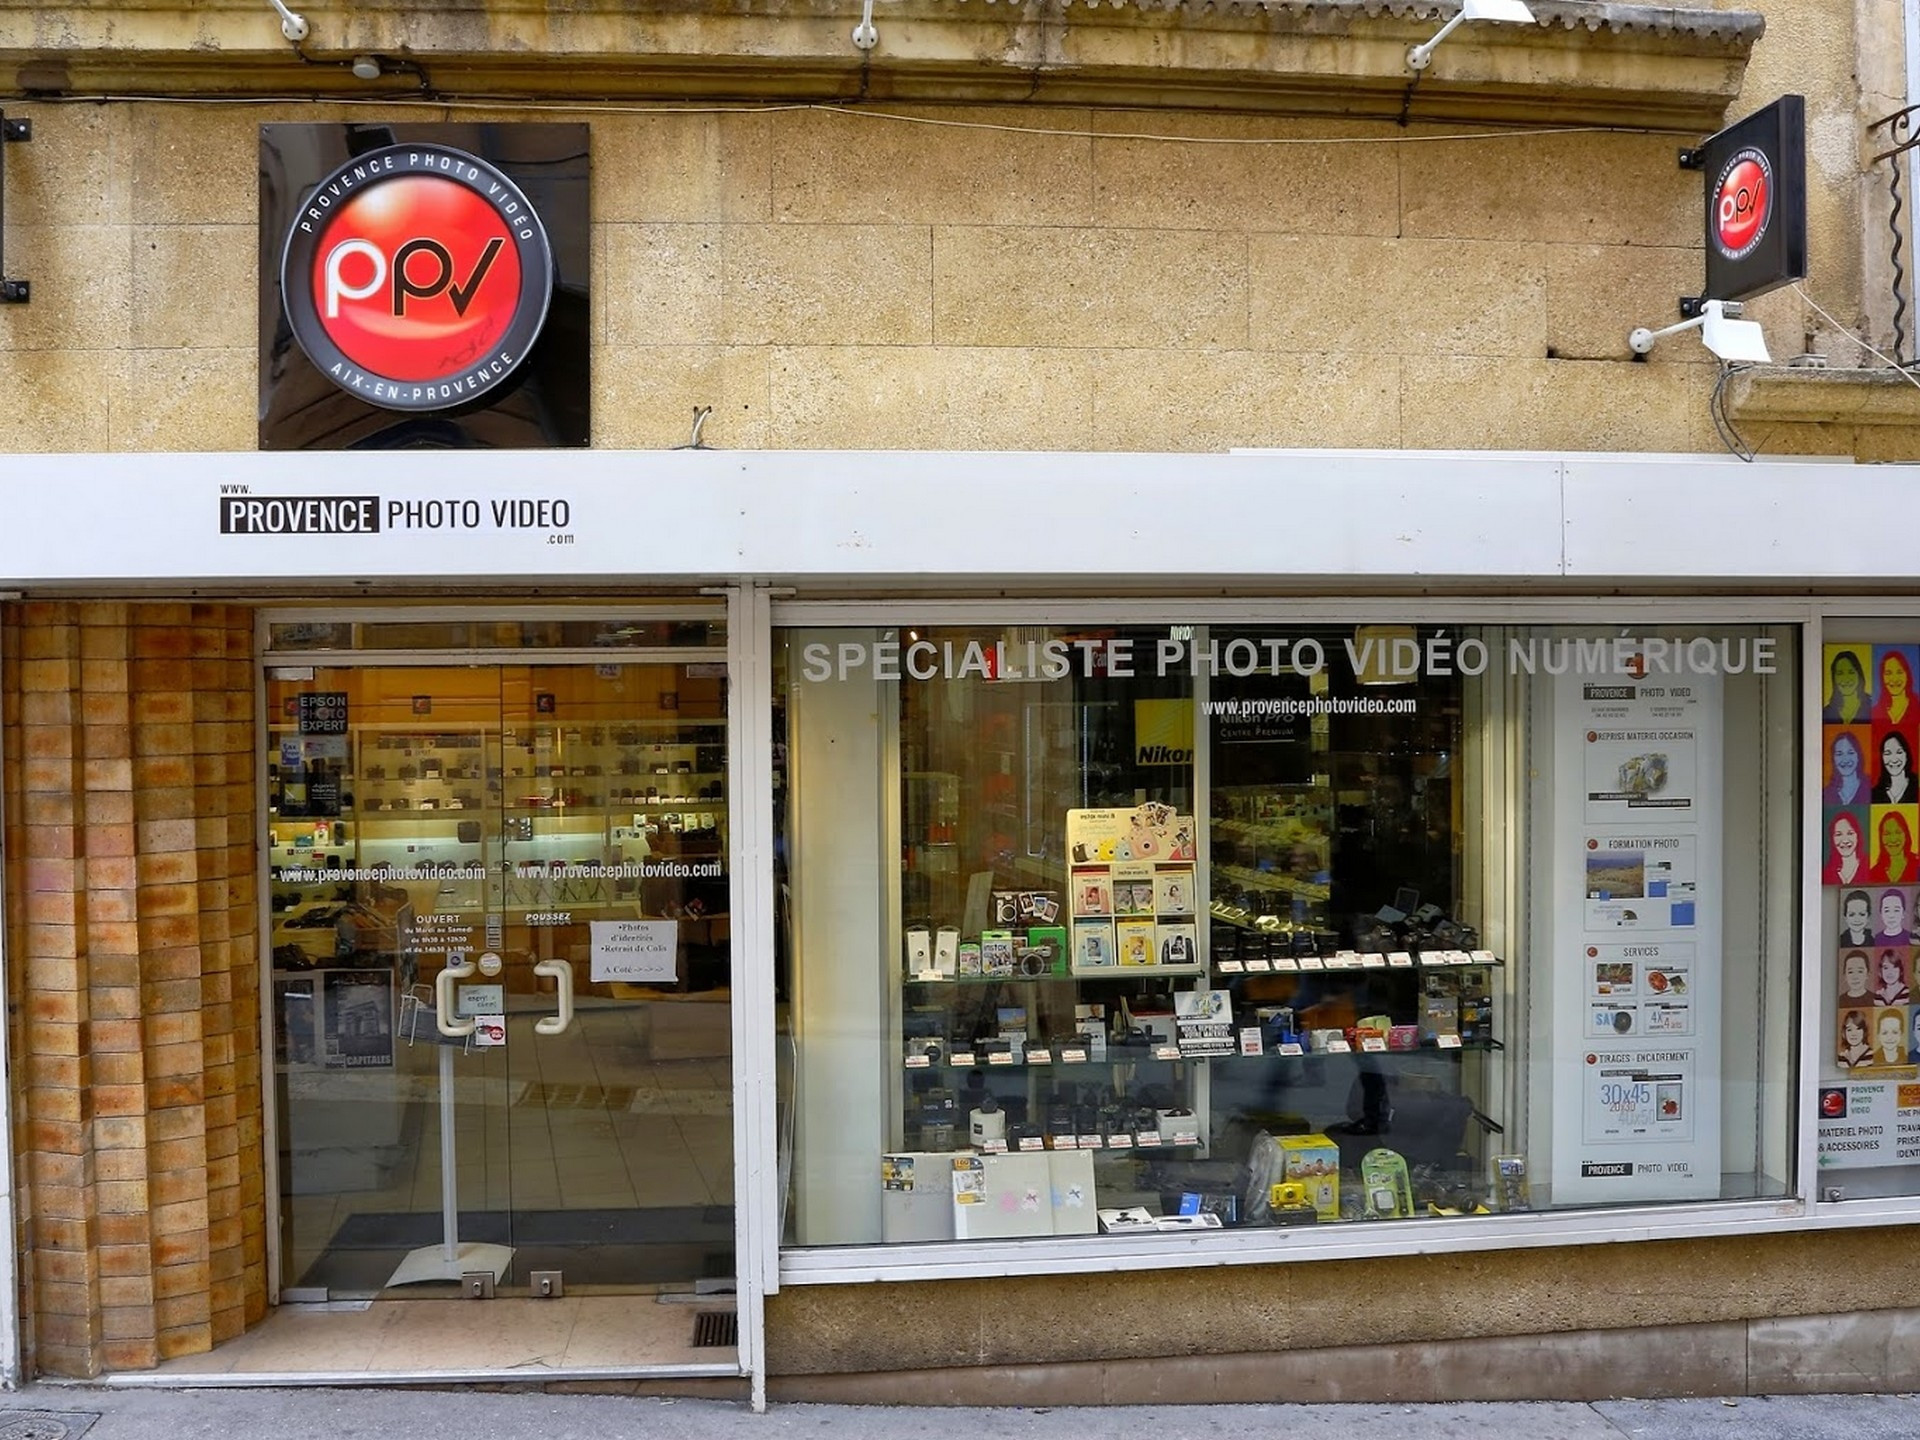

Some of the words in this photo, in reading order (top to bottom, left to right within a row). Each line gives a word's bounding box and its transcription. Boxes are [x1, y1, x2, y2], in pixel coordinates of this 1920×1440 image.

[301, 155, 395, 233] PROVENCE
[409, 152, 480, 182] PHOTO
[488, 181, 534, 241] VIDÉO
[330, 351, 513, 400] AIX-EN-PROVENCE
[229, 500, 373, 532] PROVENCE
[388, 500, 480, 529] PHOTO
[491, 499, 570, 528] VIDEO
[546, 534, 575, 545] .com
[802, 632, 1135, 682] SPÉCIALISTE
[1156, 637, 1325, 678] PHOTO
[1343, 630, 1489, 677] VIDÉO
[1510, 629, 1778, 677] NUMÉRIQUE
[1640, 687, 1665, 697] PHOTO
[1669, 687, 1691, 697] VIDEO
[300, 696, 346, 707] EPSON
[1201, 697, 1417, 717] www.provencephotovideo.com
[300, 719, 346, 731] EXPERT
[1609, 839, 1652, 849] FORMATION
[1653, 838, 1680, 848] PHOTO
[280, 862, 486, 883] www.provencephotovideo.com
[515, 861, 722, 881] www.provencephotovideo.com
[416, 915, 461, 924] OUVERT
[525, 912, 571, 921] POUSSEZ
[604, 944, 633, 952] Retrait
[1623, 946, 1660, 957] SERVICES
[347, 1054, 391, 1066] CAPITALES
[1599, 1053, 1631, 1064] TIRAGES
[1636, 1051, 1690, 1063] ENCADREMENT
[1600, 1083, 1651, 1105] 30x45
[1851, 1085, 1885, 1094] PROVENCE
[1898, 1085, 1920, 1097] Kod
[1851, 1096, 1872, 1104] PHOTO
[1851, 1106, 1871, 1114] VIDEO
[1818, 1127, 1857, 1138] MATERIEL
[1858, 1125, 1884, 1136] PHOTO
[1826, 1140, 1880, 1152] ACCESSOIRES
[1588, 1165, 1625, 1175] PROVENCE
[1637, 1163, 1662, 1174] PHOTO
[1667, 1163, 1688, 1172] VIDEO
